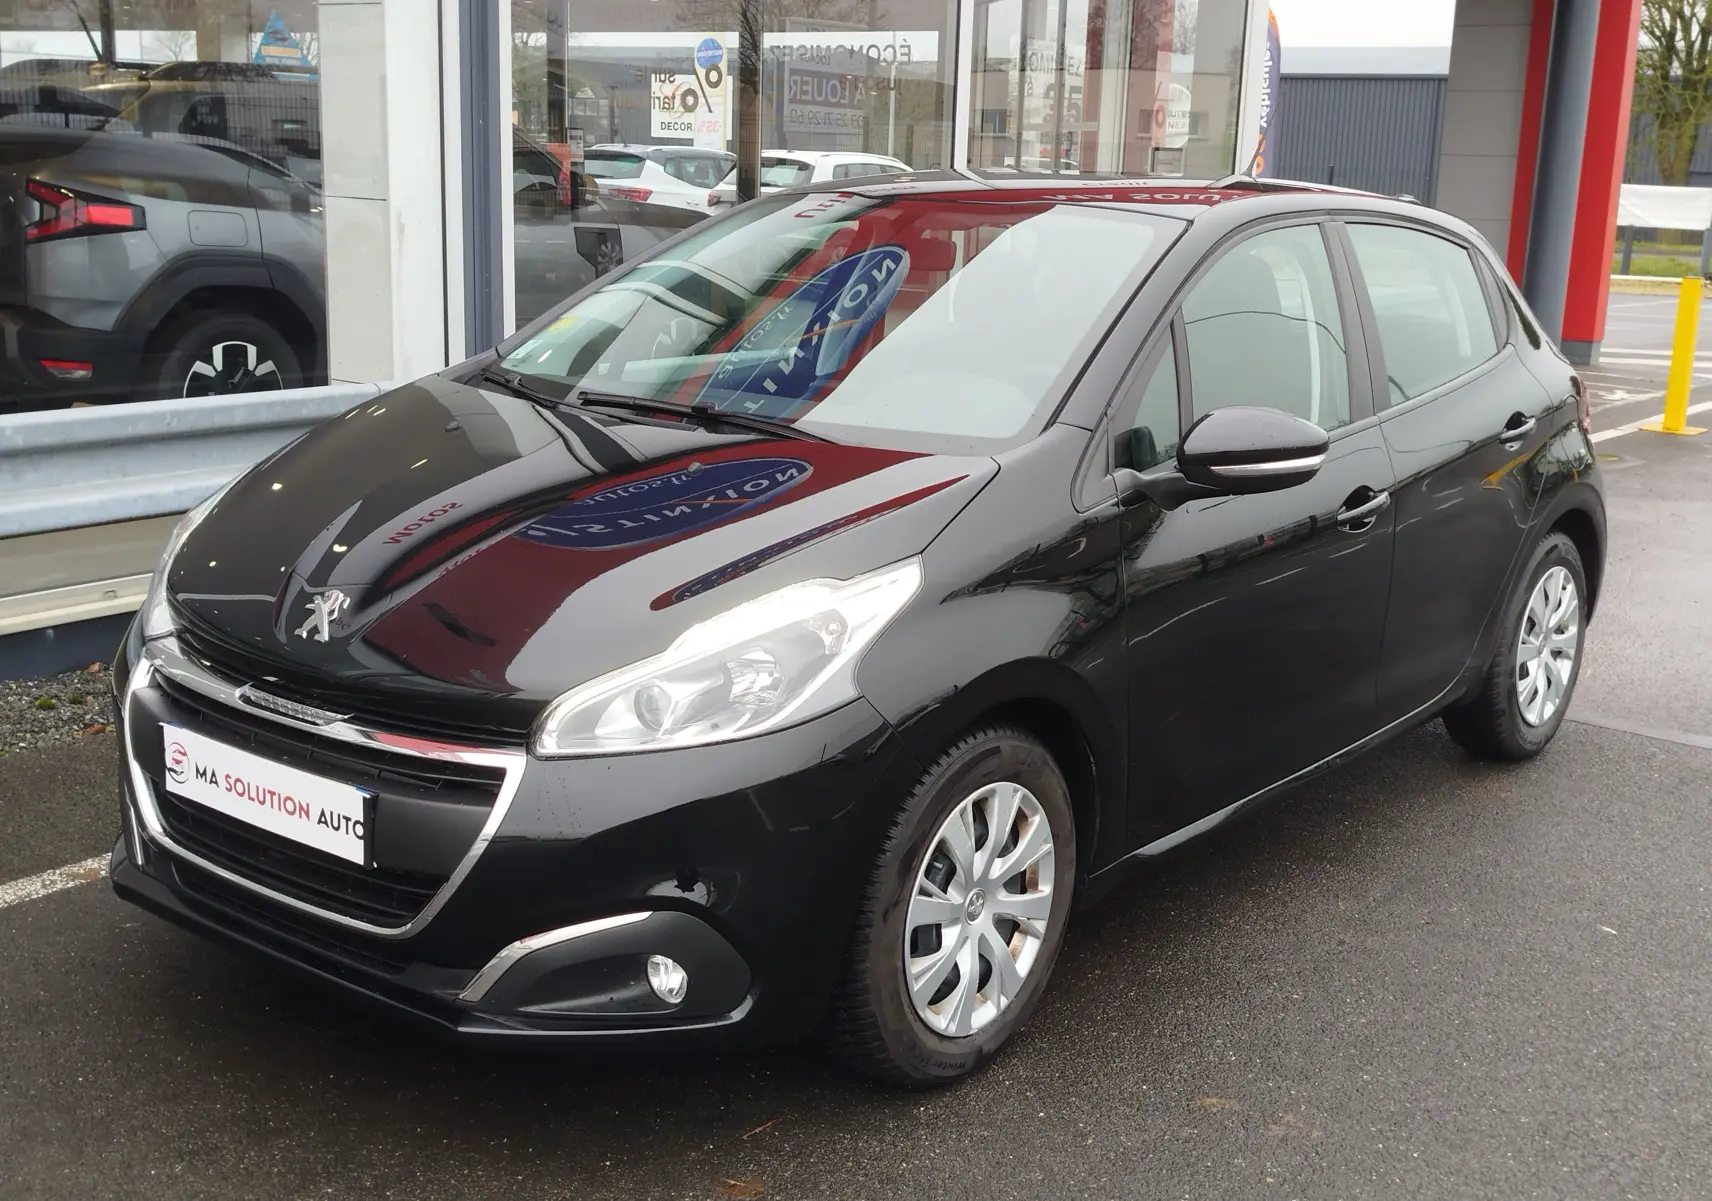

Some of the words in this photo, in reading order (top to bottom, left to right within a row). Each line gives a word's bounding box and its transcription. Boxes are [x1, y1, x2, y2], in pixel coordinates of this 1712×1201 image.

[660, 121, 693, 132] DECOR
[195, 762, 220, 788] MA
[224, 774, 311, 821] SOLUTION
[316, 807, 364, 841] AUTO
